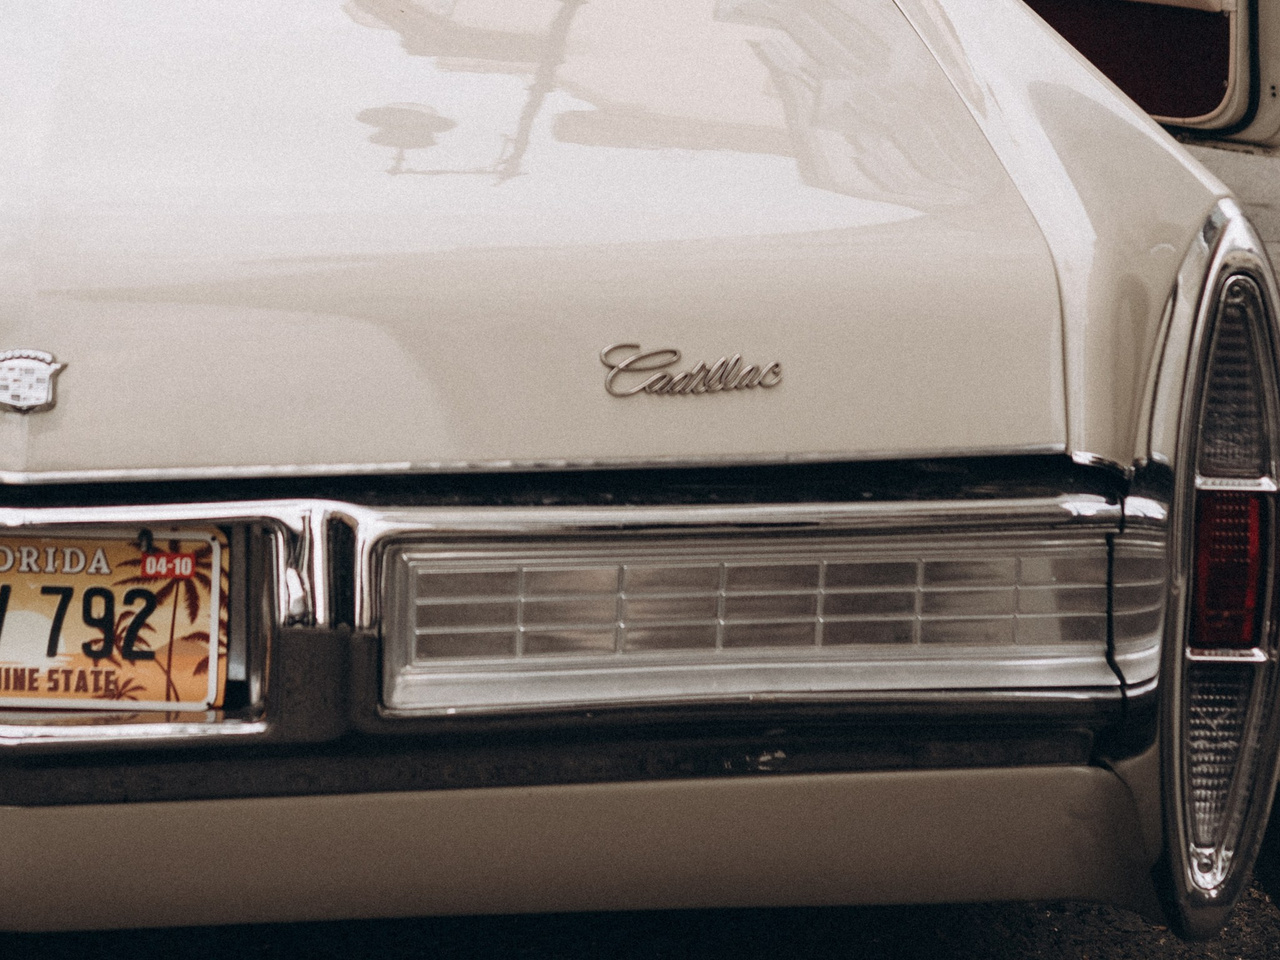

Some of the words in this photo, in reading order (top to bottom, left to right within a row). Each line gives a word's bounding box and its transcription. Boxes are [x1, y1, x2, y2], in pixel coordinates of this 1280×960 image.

[599, 343, 783, 397] Cadillac
[145, 555, 193, 577] 04-10
[40, 586, 158, 661] 792
[46, 667, 117, 695] STATE
